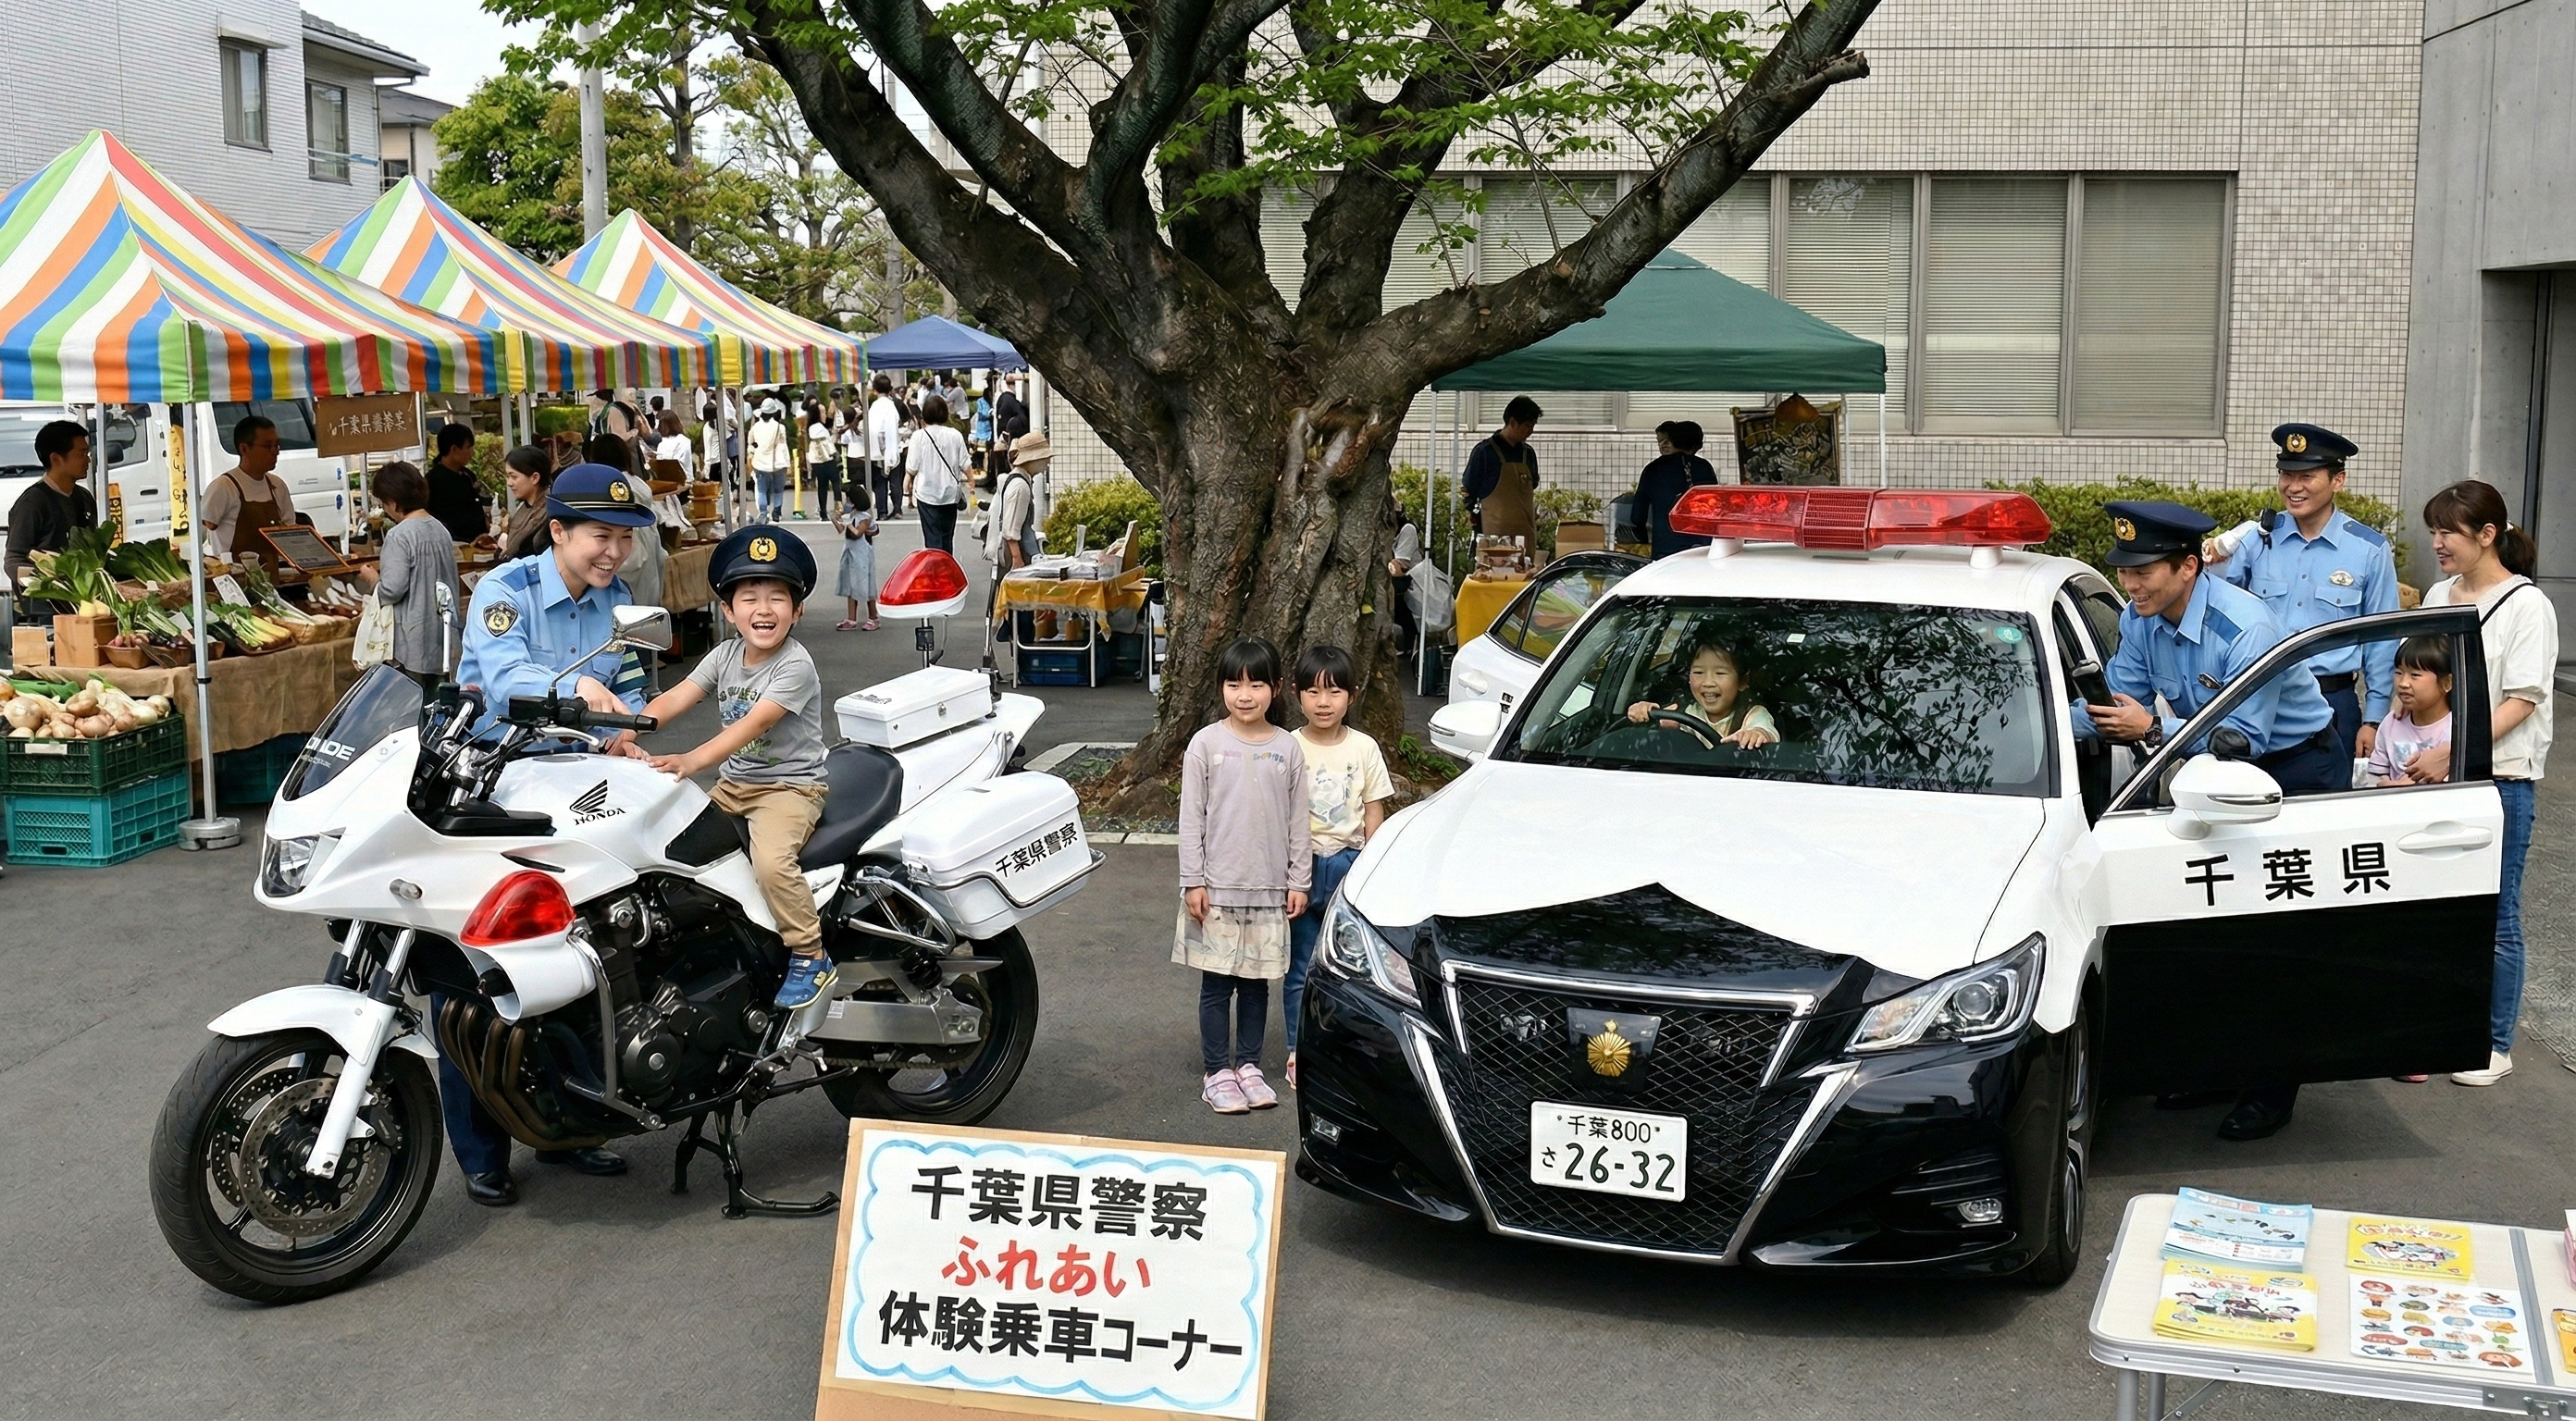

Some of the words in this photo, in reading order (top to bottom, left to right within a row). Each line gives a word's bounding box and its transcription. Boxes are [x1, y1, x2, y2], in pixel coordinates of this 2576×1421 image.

[573, 808, 626, 826] HONDA
[995, 822, 1078, 878] 千葉県警察
[2185, 841, 2392, 907] 千葉県
[1541, 1146, 1557, 1168] さ
[1565, 1143, 1675, 1193] 26-32
[910, 1165, 1208, 1242] 千葉県警察
[941, 1235, 1151, 1298] ふれあい
[878, 1290, 1243, 1372] 体験乗車コーナー
